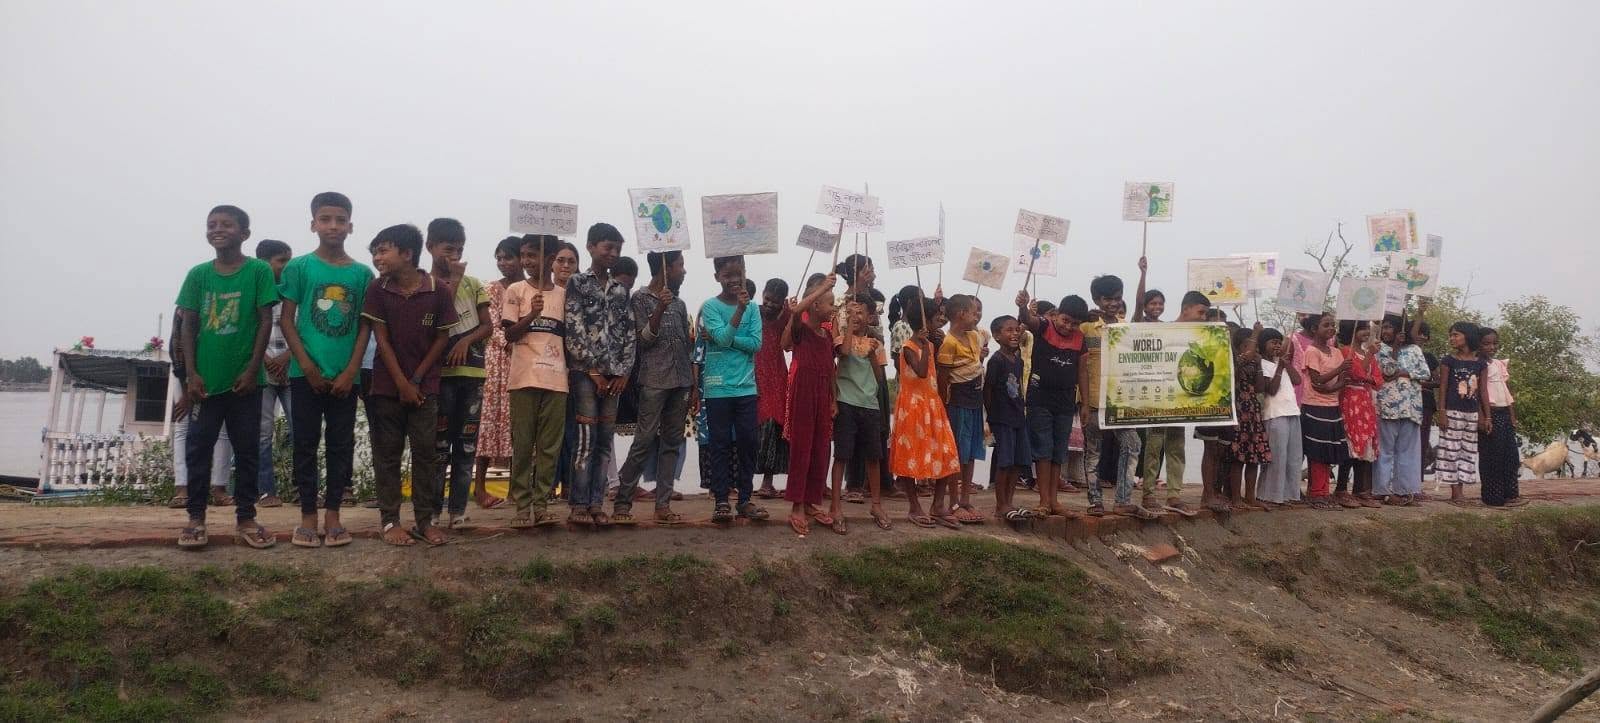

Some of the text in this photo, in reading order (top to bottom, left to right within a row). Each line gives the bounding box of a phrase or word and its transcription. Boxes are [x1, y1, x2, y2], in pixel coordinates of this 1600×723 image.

[1133, 339, 1162, 351] WORLD
[1118, 352, 1177, 363] ENVIRONMENT DAY
